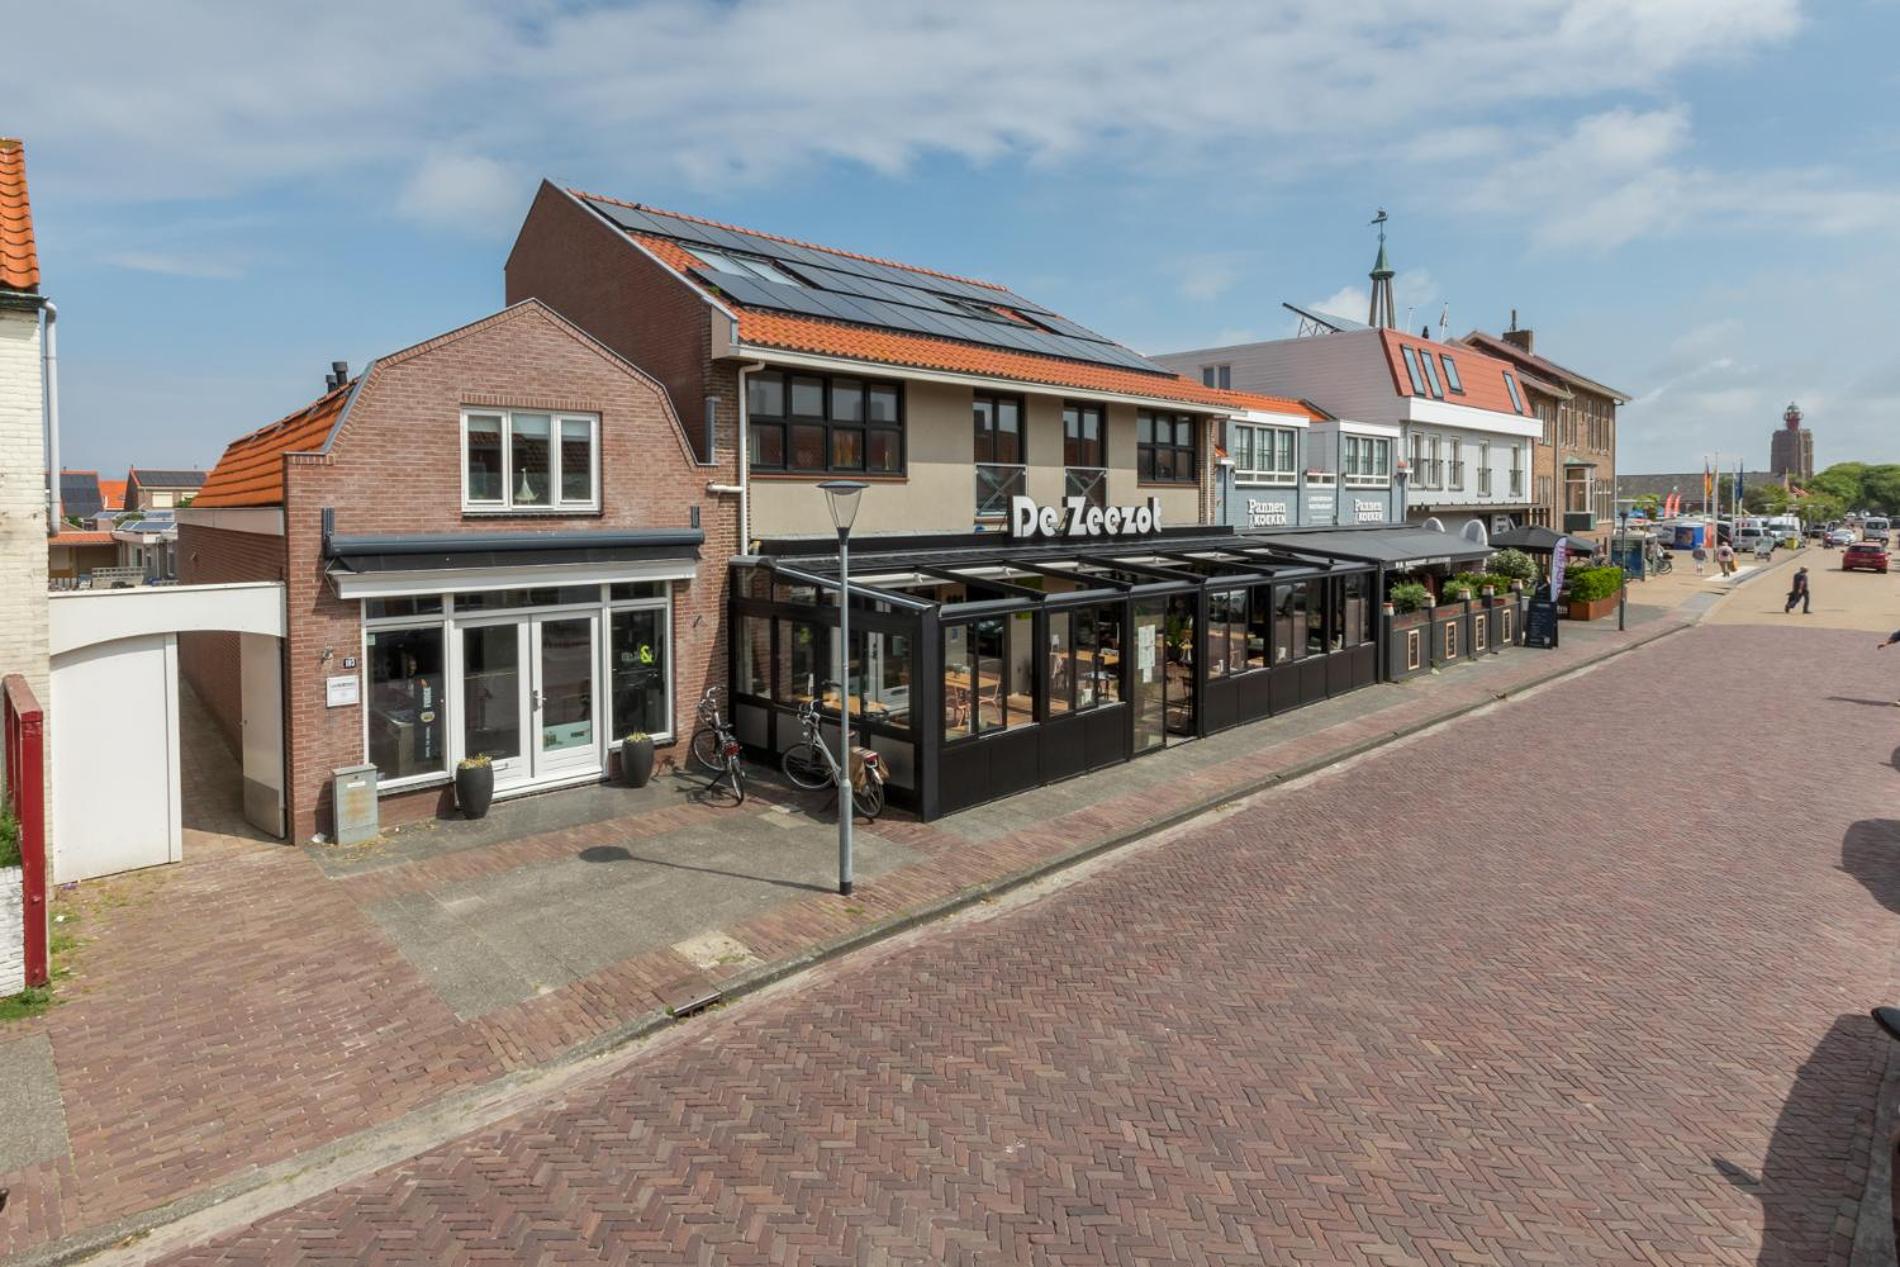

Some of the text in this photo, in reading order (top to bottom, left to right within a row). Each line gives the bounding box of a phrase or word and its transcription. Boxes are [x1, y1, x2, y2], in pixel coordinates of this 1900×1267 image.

[1248, 499, 1286, 514] Pannen
[1012, 496, 1162, 538] De Zeezot
[1254, 514, 1287, 526] KOEKEN
